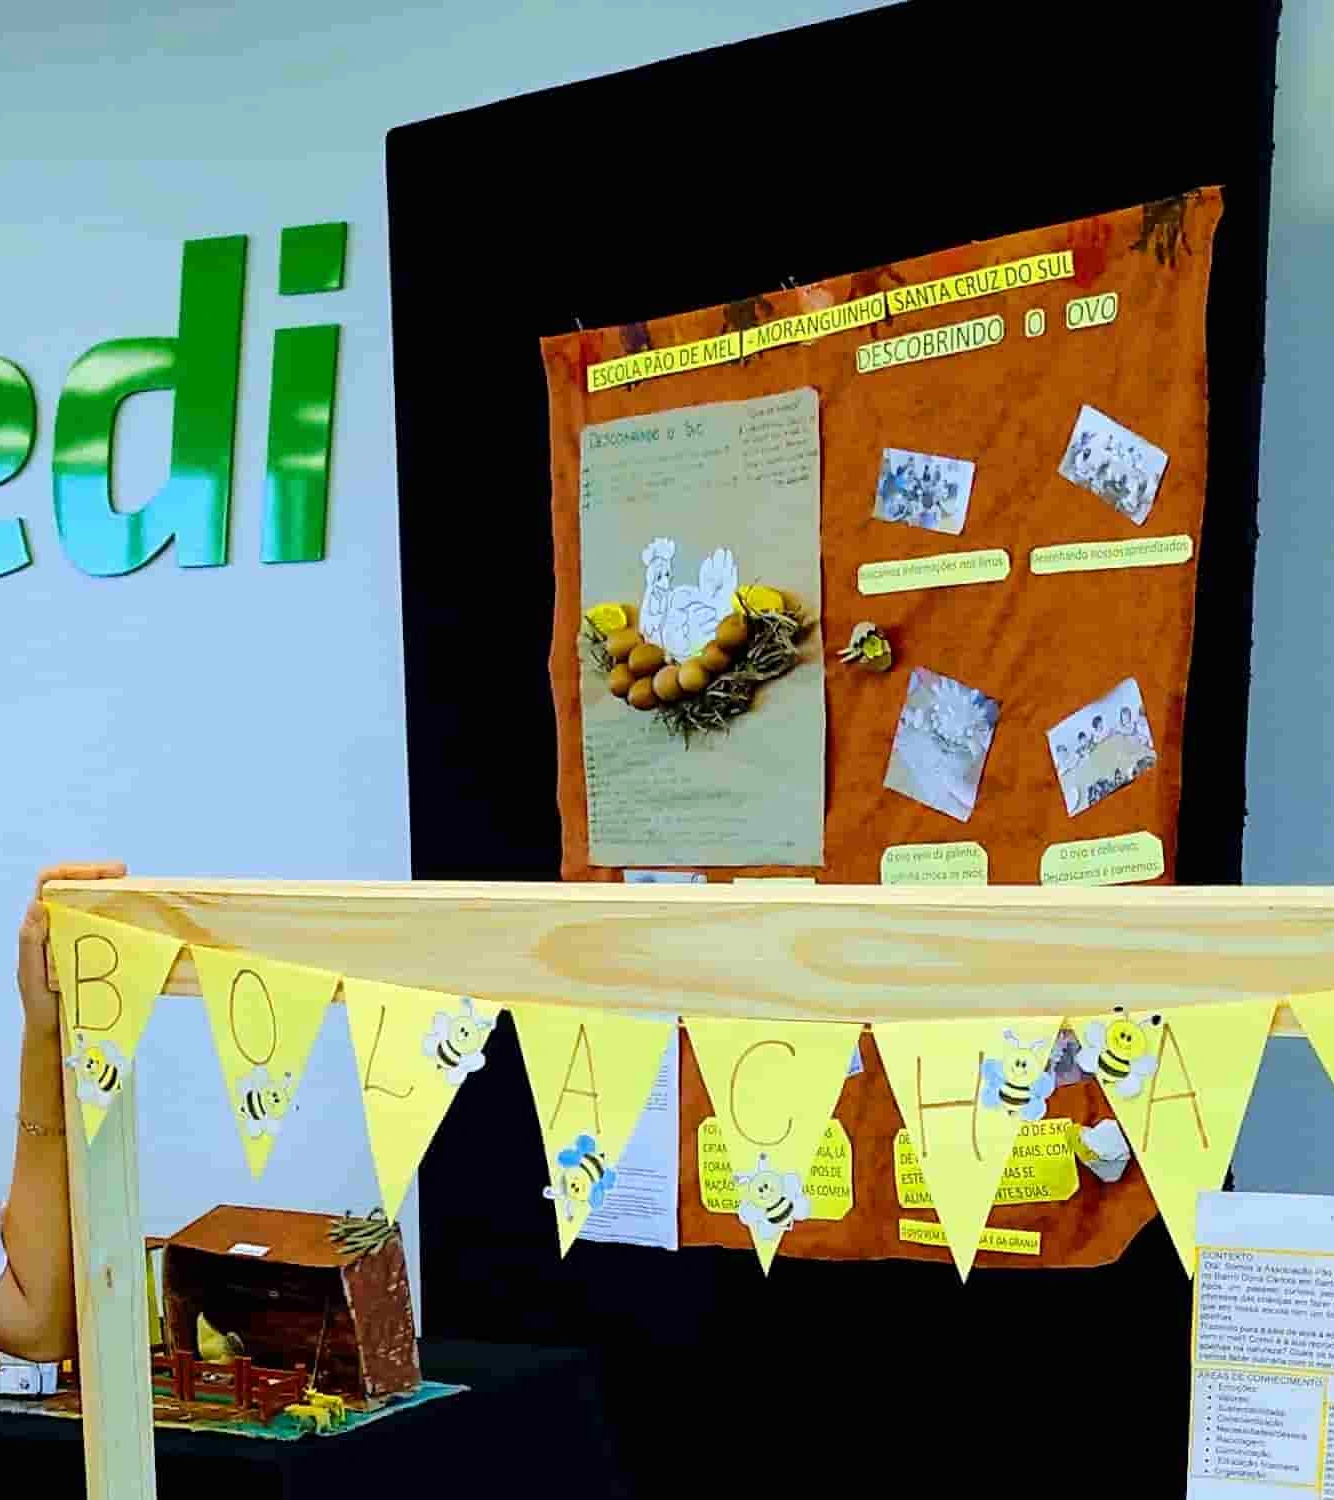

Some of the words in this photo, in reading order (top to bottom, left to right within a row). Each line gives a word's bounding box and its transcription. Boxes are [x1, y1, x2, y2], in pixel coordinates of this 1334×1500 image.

[592, 365, 642, 387] ESCOLA
[645, 349, 674, 375] PÃO
[678, 346, 700, 366] DE
[702, 338, 735, 363] MEL
[757, 299, 883, 345] MORANGUINHO
[893, 288, 949, 312] SANTA
[954, 275, 999, 302] CRUZ
[1004, 266, 1033, 286] DO
[1035, 257, 1072, 280] SUL
[858, 318, 1003, 369] DESCOBRINDO
[1028, 314, 1042, 335] O
[1068, 297, 1116, 326] OVO
